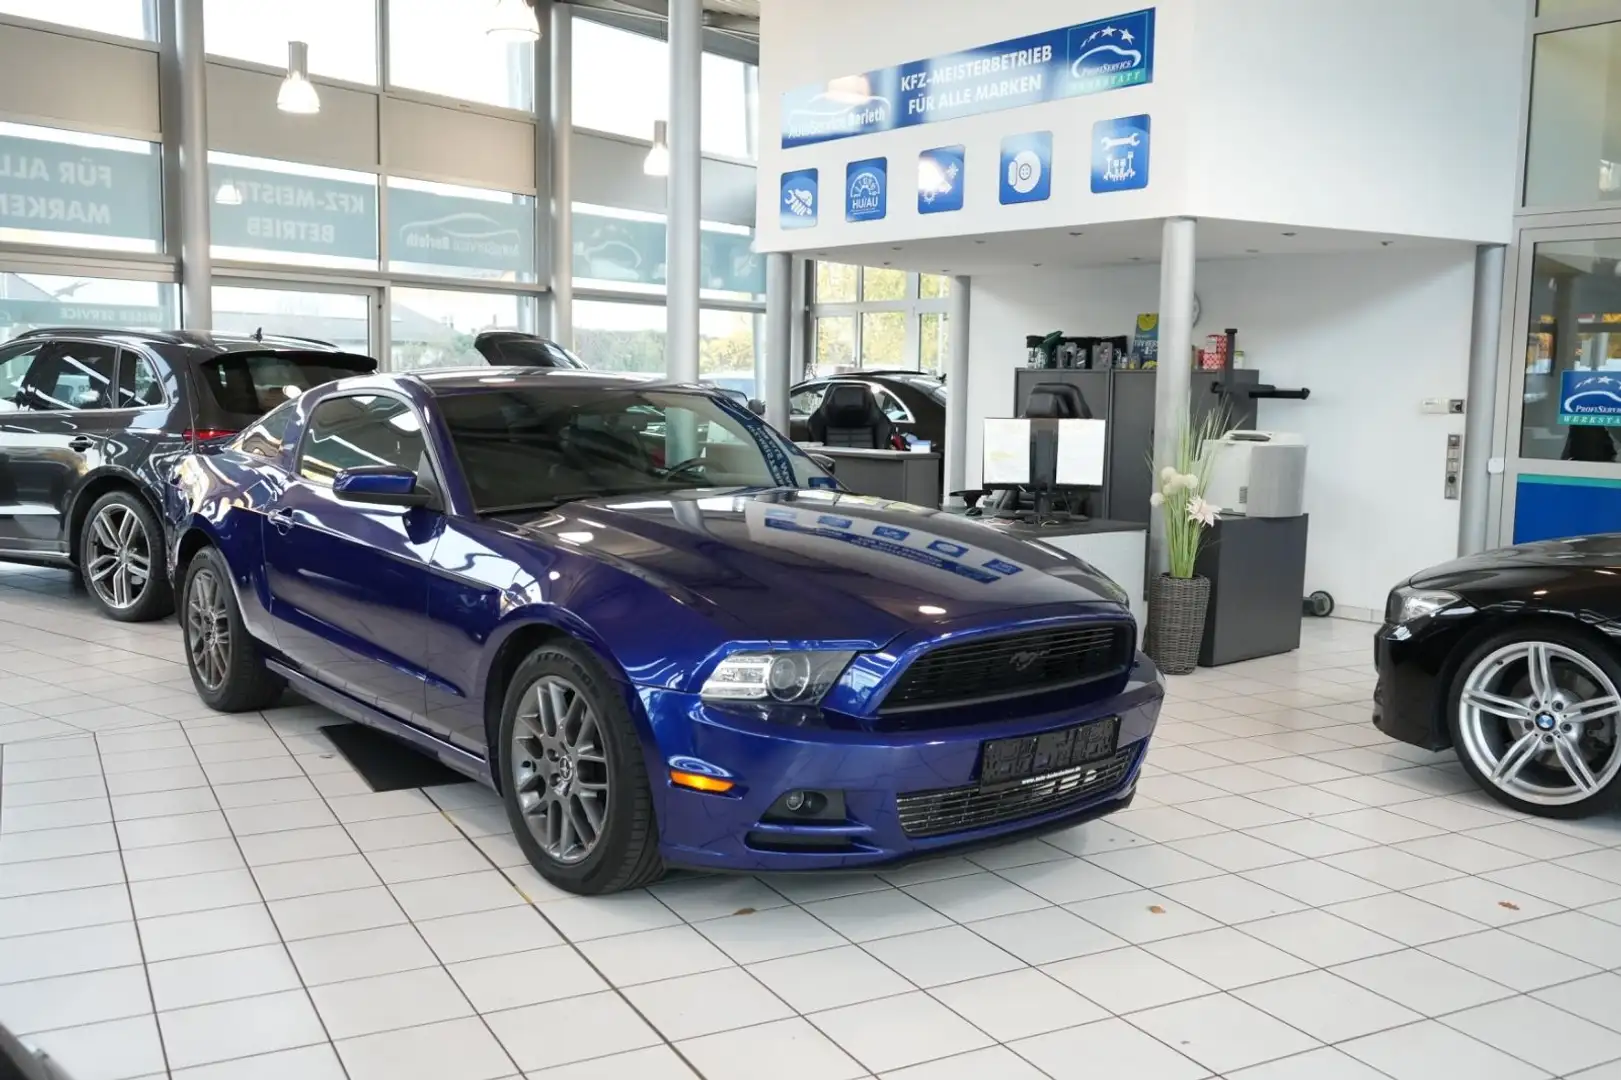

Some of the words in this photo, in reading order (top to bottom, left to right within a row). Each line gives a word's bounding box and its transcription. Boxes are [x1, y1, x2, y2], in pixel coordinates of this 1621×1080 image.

[901, 44, 1053, 92] KFZ-MEISTERBETRIEB
[908, 93, 935, 115] FÜR
[938, 87, 972, 110] ALLE
[975, 73, 1043, 103] MARKEN
[852, 196, 879, 210] HU/AU
